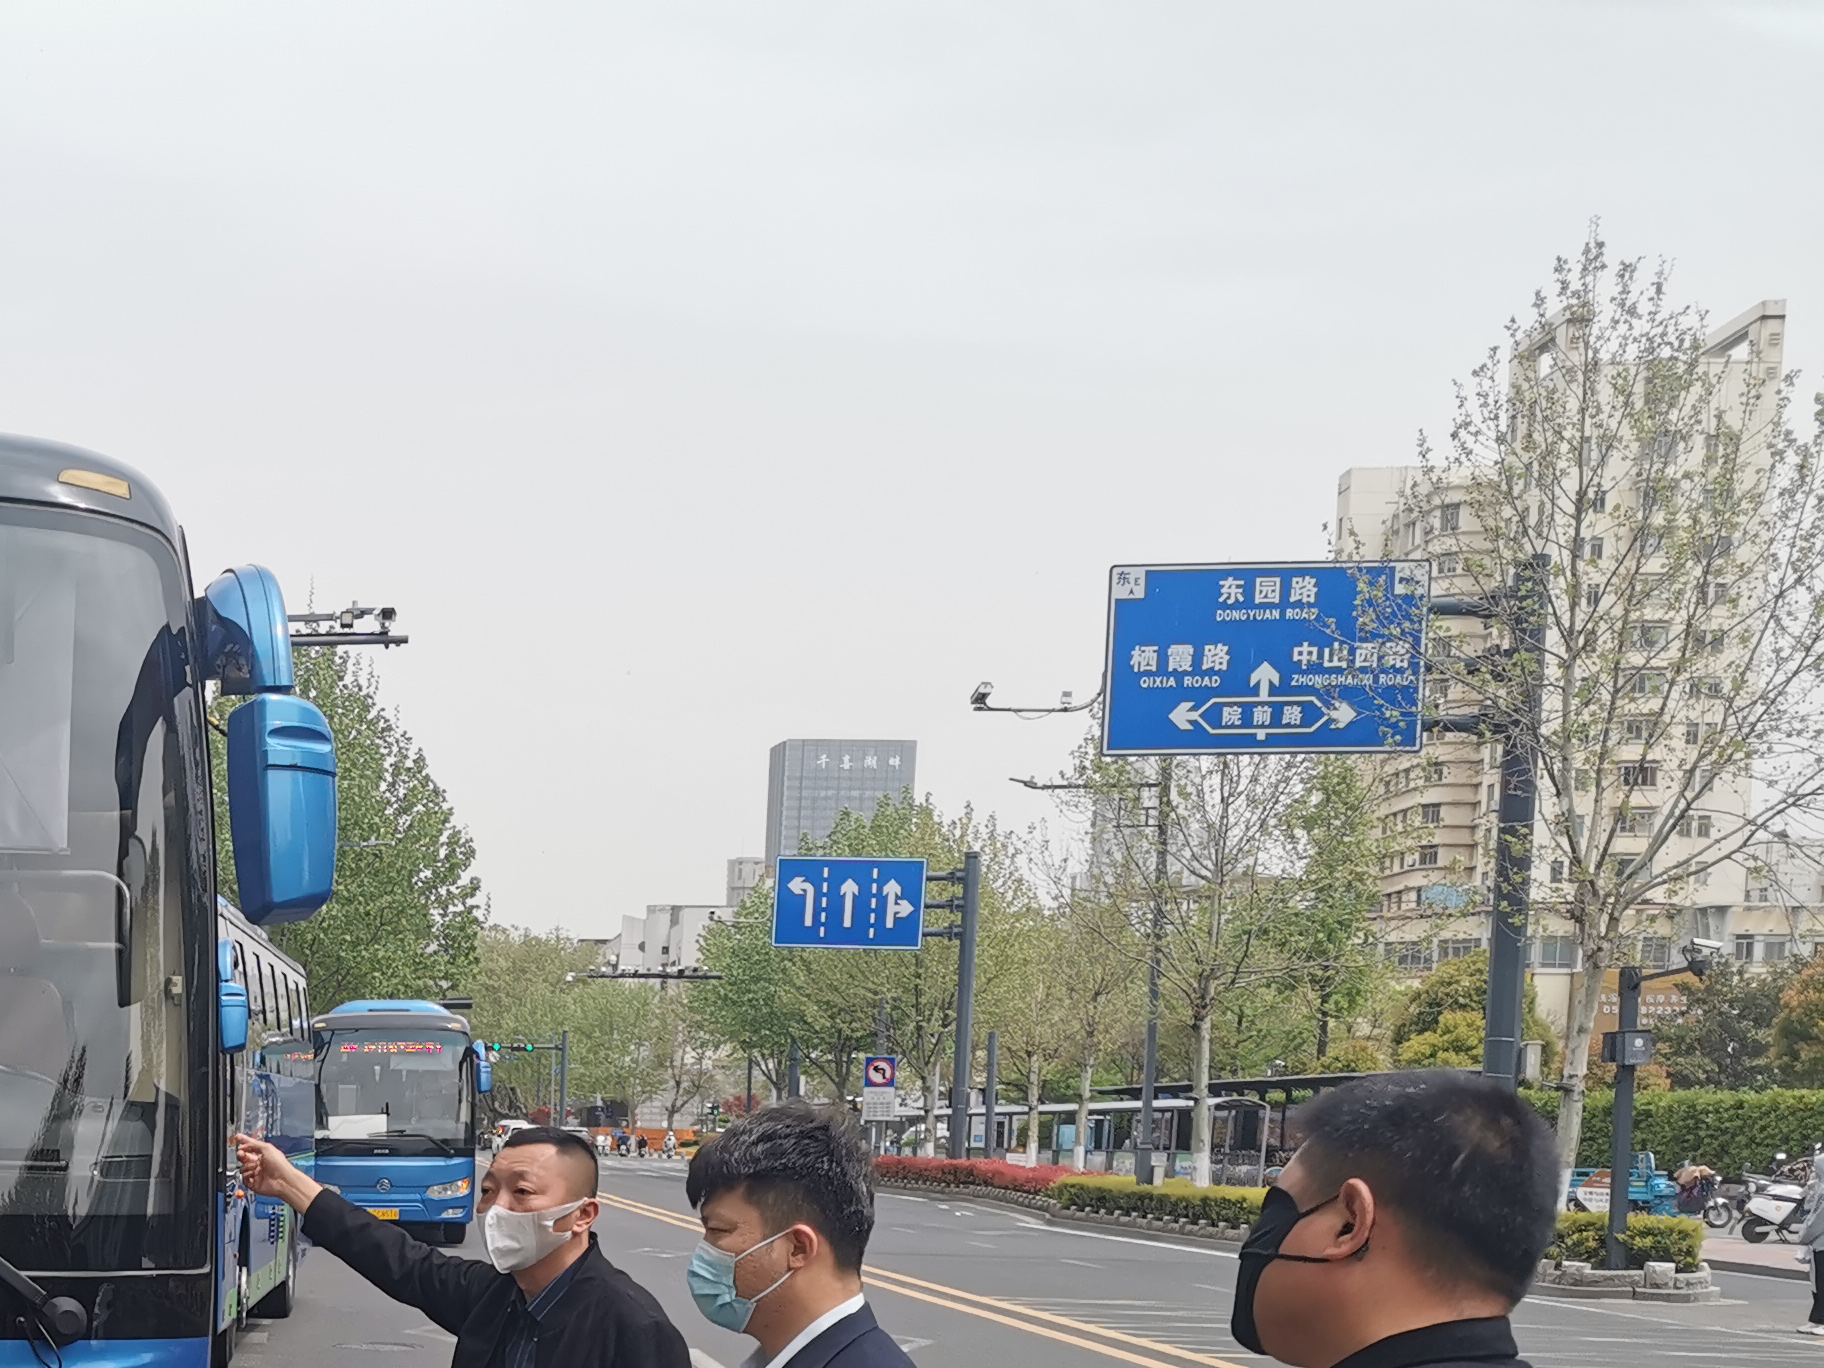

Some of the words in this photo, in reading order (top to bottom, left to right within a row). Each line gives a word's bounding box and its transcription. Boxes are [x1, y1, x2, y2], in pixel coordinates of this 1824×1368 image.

[1116, 571, 1131, 586] 东
[1134, 577, 1140, 586] E
[1218, 576, 1318, 604] 东园路
[1216, 610, 1280, 621] DONGYUAN
[1285, 608, 1318, 620] ROAD
[1130, 644, 1231, 672] 栖霞路
[1292, 641, 1411, 669] 中山西路
[1140, 676, 1176, 688] QIXIA
[1184, 676, 1221, 688] ROAD
[1379, 673, 1412, 686] ROAD
[1221, 705, 1303, 727] 院前路
